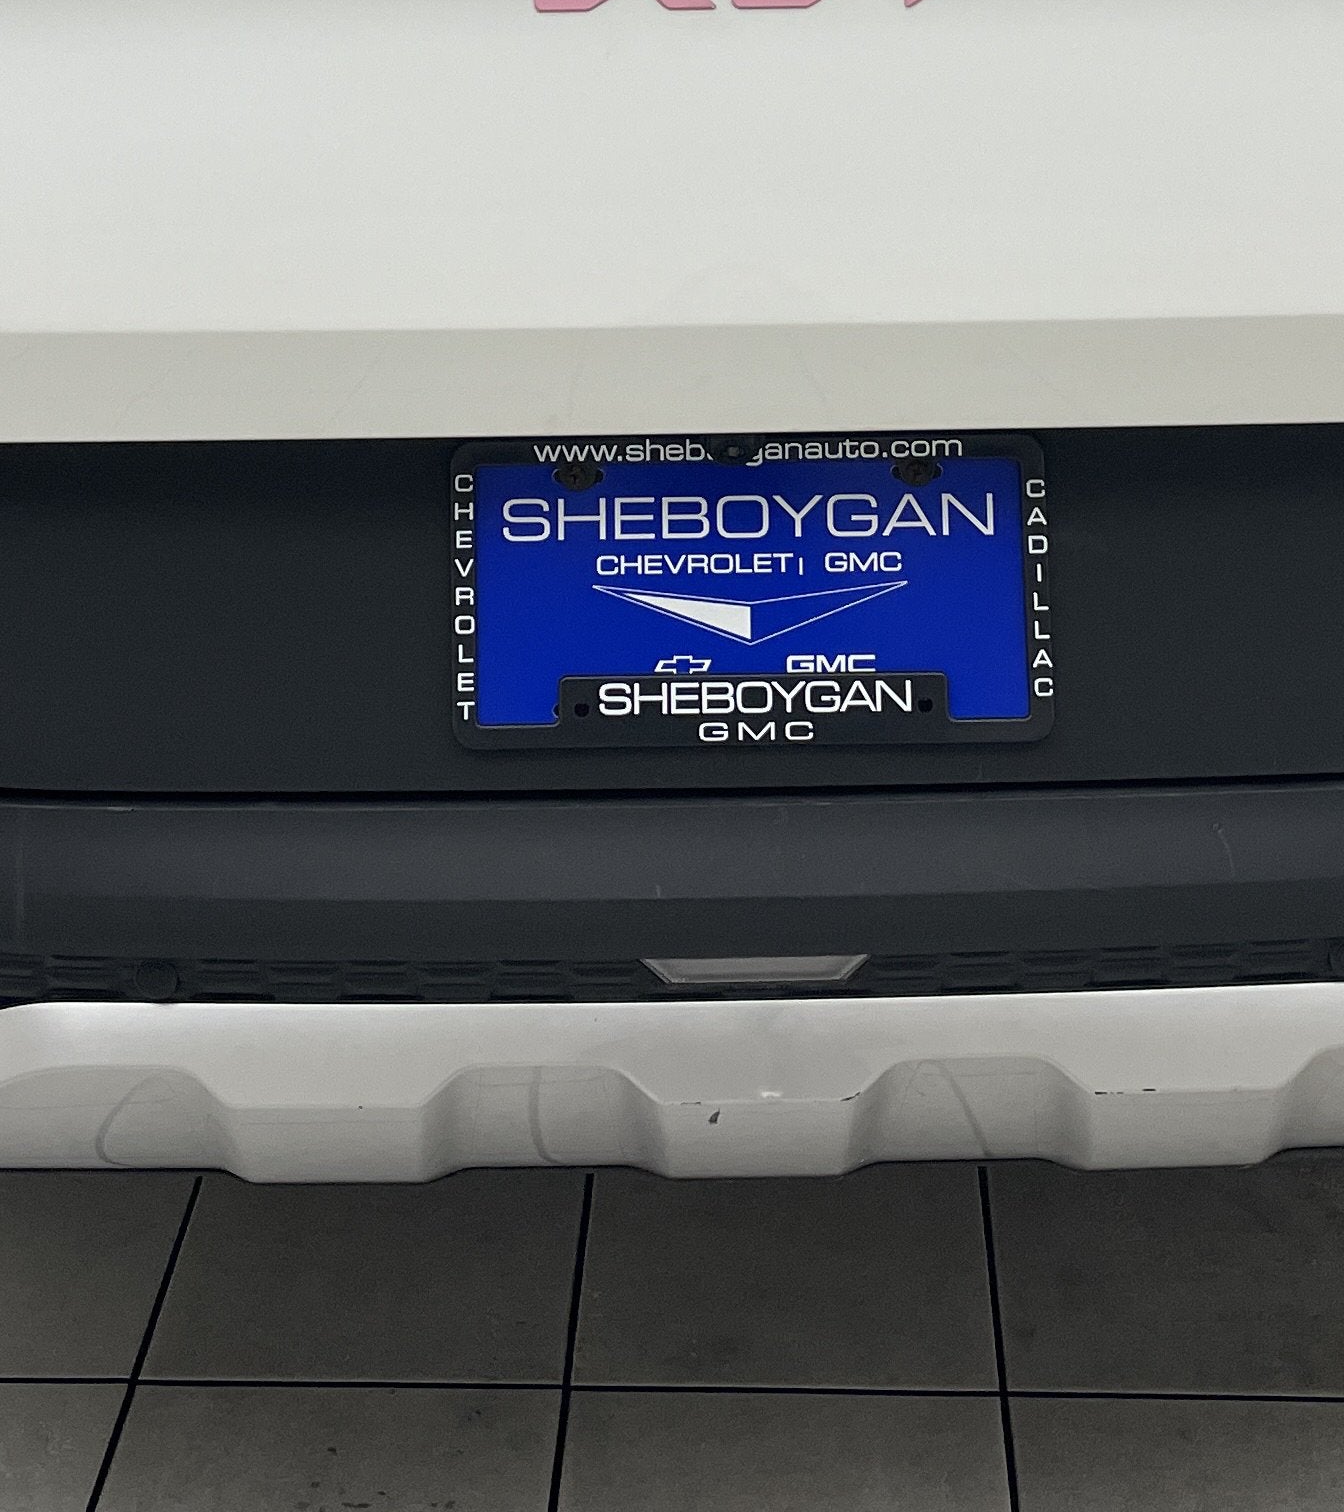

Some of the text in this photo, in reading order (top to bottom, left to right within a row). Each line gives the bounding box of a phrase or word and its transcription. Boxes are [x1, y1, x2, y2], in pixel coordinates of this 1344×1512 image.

[502, 492, 995, 542] SHEBOYGAN
[596, 551, 903, 575] CHEVROLET GMC
[454, 474, 476, 720] CHEVROLET
[1025, 479, 1054, 698] CADILLAC
[786, 654, 876, 673] GMC
[598, 679, 913, 716] SHEBOYGAN
[698, 721, 815, 742] GMC
